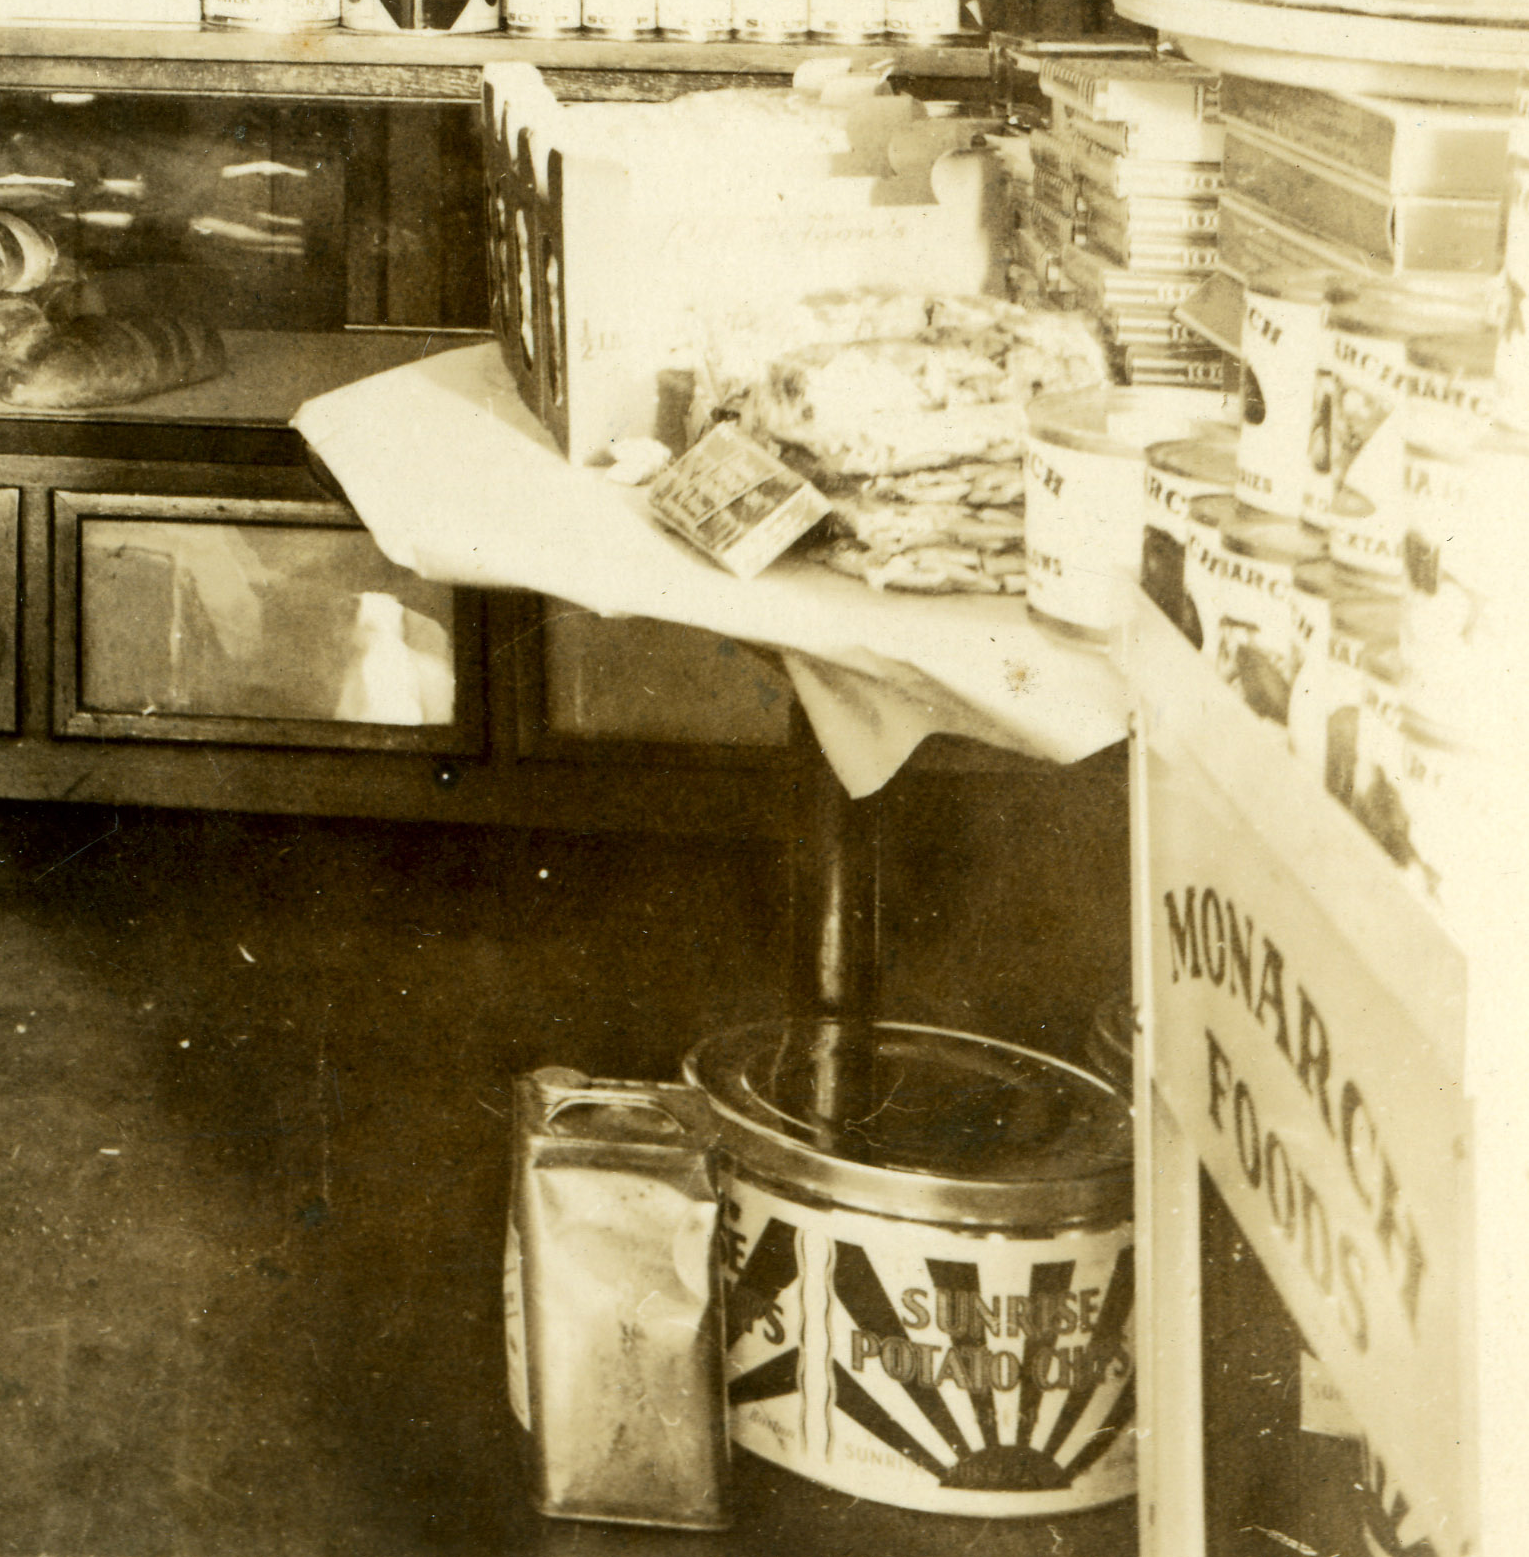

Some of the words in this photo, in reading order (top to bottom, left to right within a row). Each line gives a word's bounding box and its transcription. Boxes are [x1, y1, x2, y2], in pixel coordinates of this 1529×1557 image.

[1163, 885, 1428, 1344] MONARCH
[1204, 1025, 1369, 1355] FOODS
[850, 1328, 1021, 1395] POTATO
[901, 1287, 1103, 1340] SUNRISE
